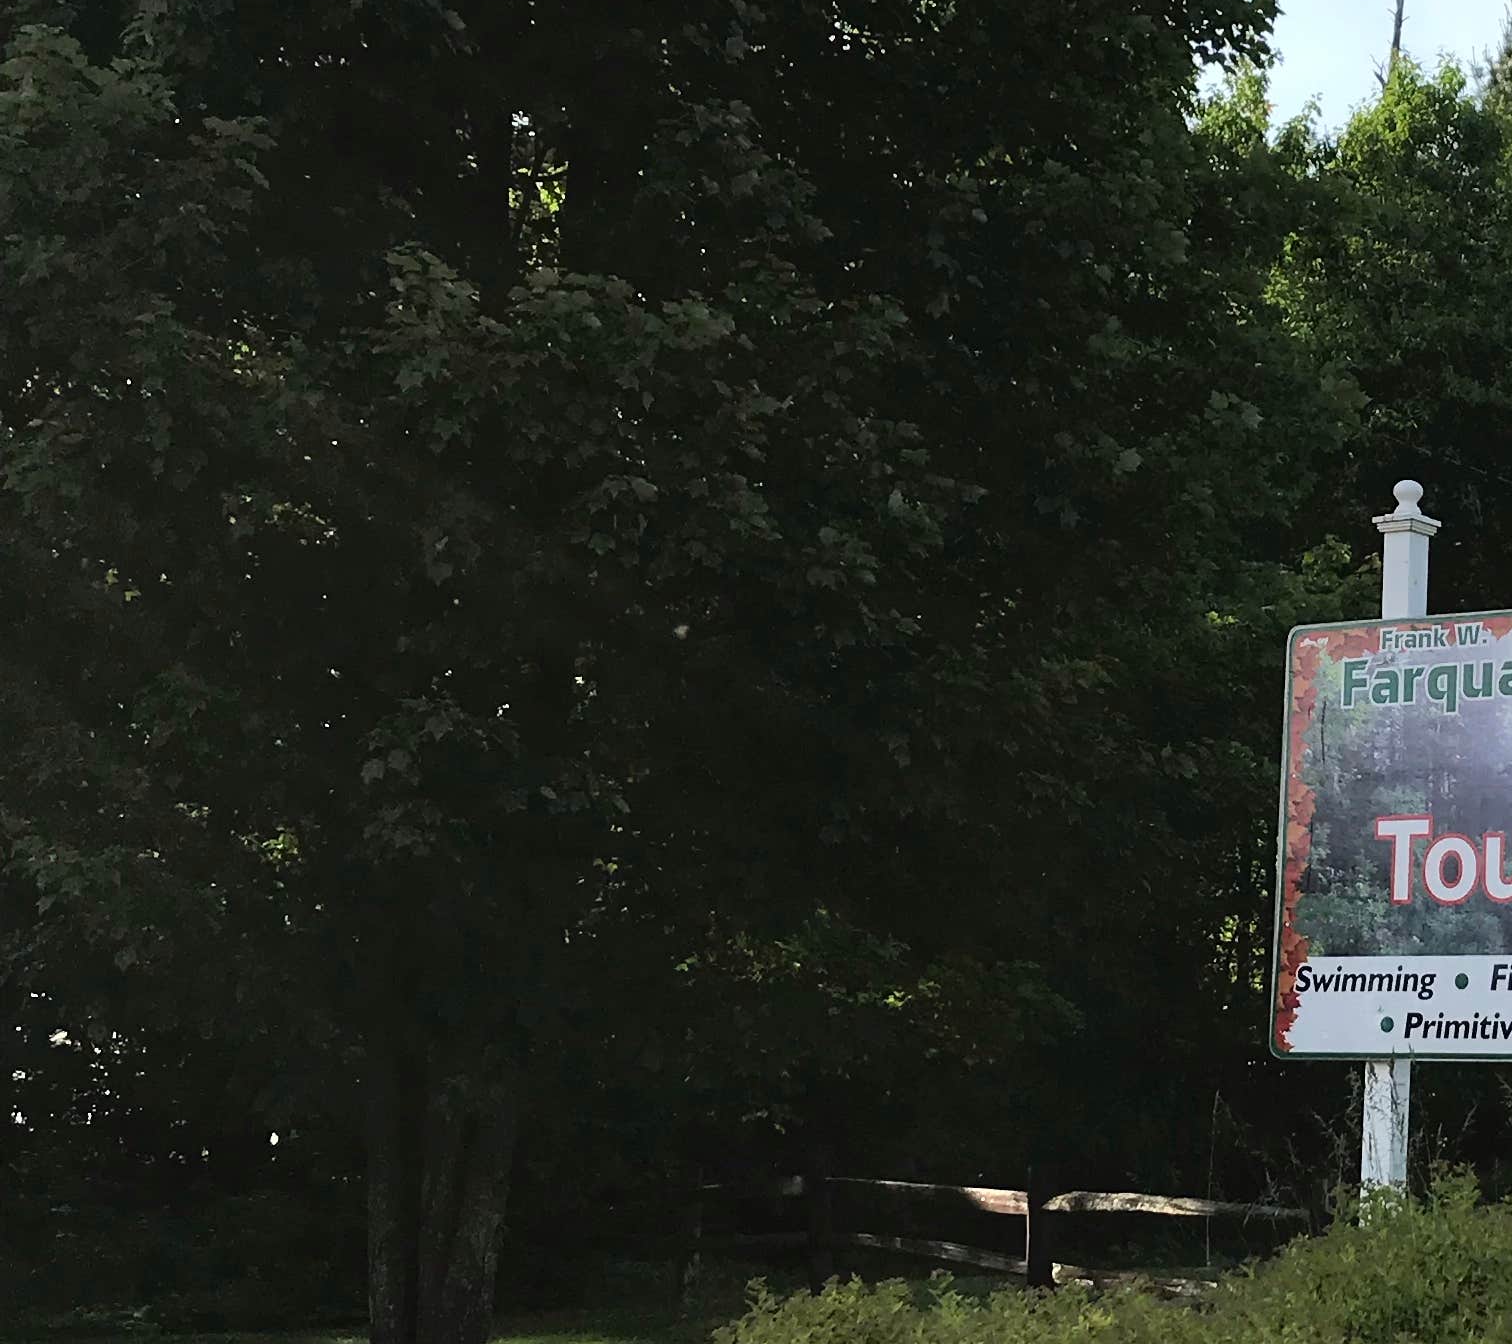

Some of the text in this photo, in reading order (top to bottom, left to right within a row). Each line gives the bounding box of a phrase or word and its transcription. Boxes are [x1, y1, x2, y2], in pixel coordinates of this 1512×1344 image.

[1381, 624, 1487, 650] Frank W.
[1296, 965, 1436, 999] Swimming
